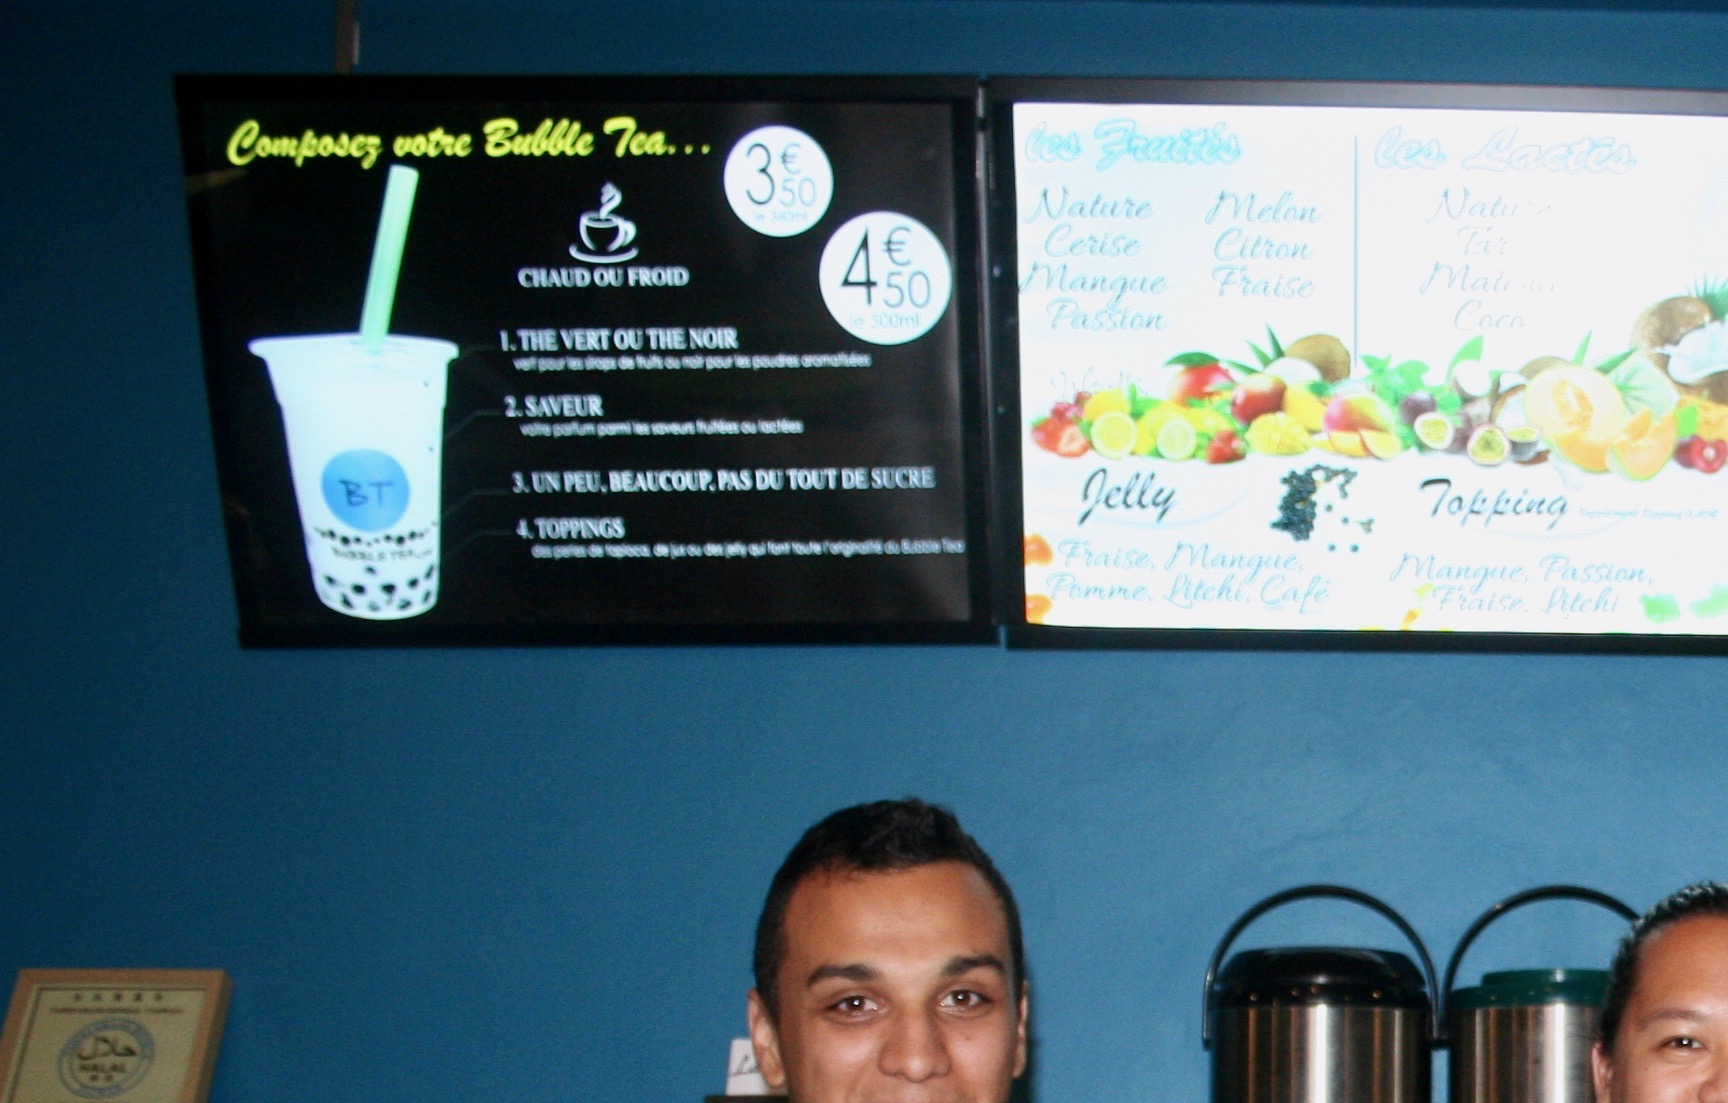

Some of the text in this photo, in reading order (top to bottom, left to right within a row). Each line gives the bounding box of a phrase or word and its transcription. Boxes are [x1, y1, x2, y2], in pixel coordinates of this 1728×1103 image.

[226, 119, 381, 169] Composez
[393, 127, 472, 157] votre
[483, 118, 594, 157] Bubble
[1024, 186, 1152, 224] Nature
[1205, 190, 1321, 225] Melon
[1045, 224, 1138, 257] Cerise
[1214, 227, 1313, 261] Citron
[518, 265, 690, 288] CHAUD OU FROID
[1018, 261, 1168, 306] Mangue
[1212, 265, 1315, 298] Fraise
[1047, 298, 1168, 332] Passion
[516, 328, 559, 351] THE
[560, 328, 612, 351] VERT
[613, 327, 644, 350] OU
[645, 327, 687, 350] THE
[689, 326, 738, 349] NOIR
[525, 394, 604, 417] SAVEUR
[339, 479, 396, 508] BT
[531, 470, 561, 493] UN
[717, 469, 752, 491] PAS
[754, 468, 784, 491] DU
[786, 467, 839, 490] TOUT
[841, 467, 870, 489] DE
[871, 465, 936, 489] SUCRE
[1078, 468, 1175, 526] Jelly
[1419, 477, 1569, 530] Topping
[535, 516, 625, 539] TOPPINGS
[1260, 575, 1330, 614] Café
